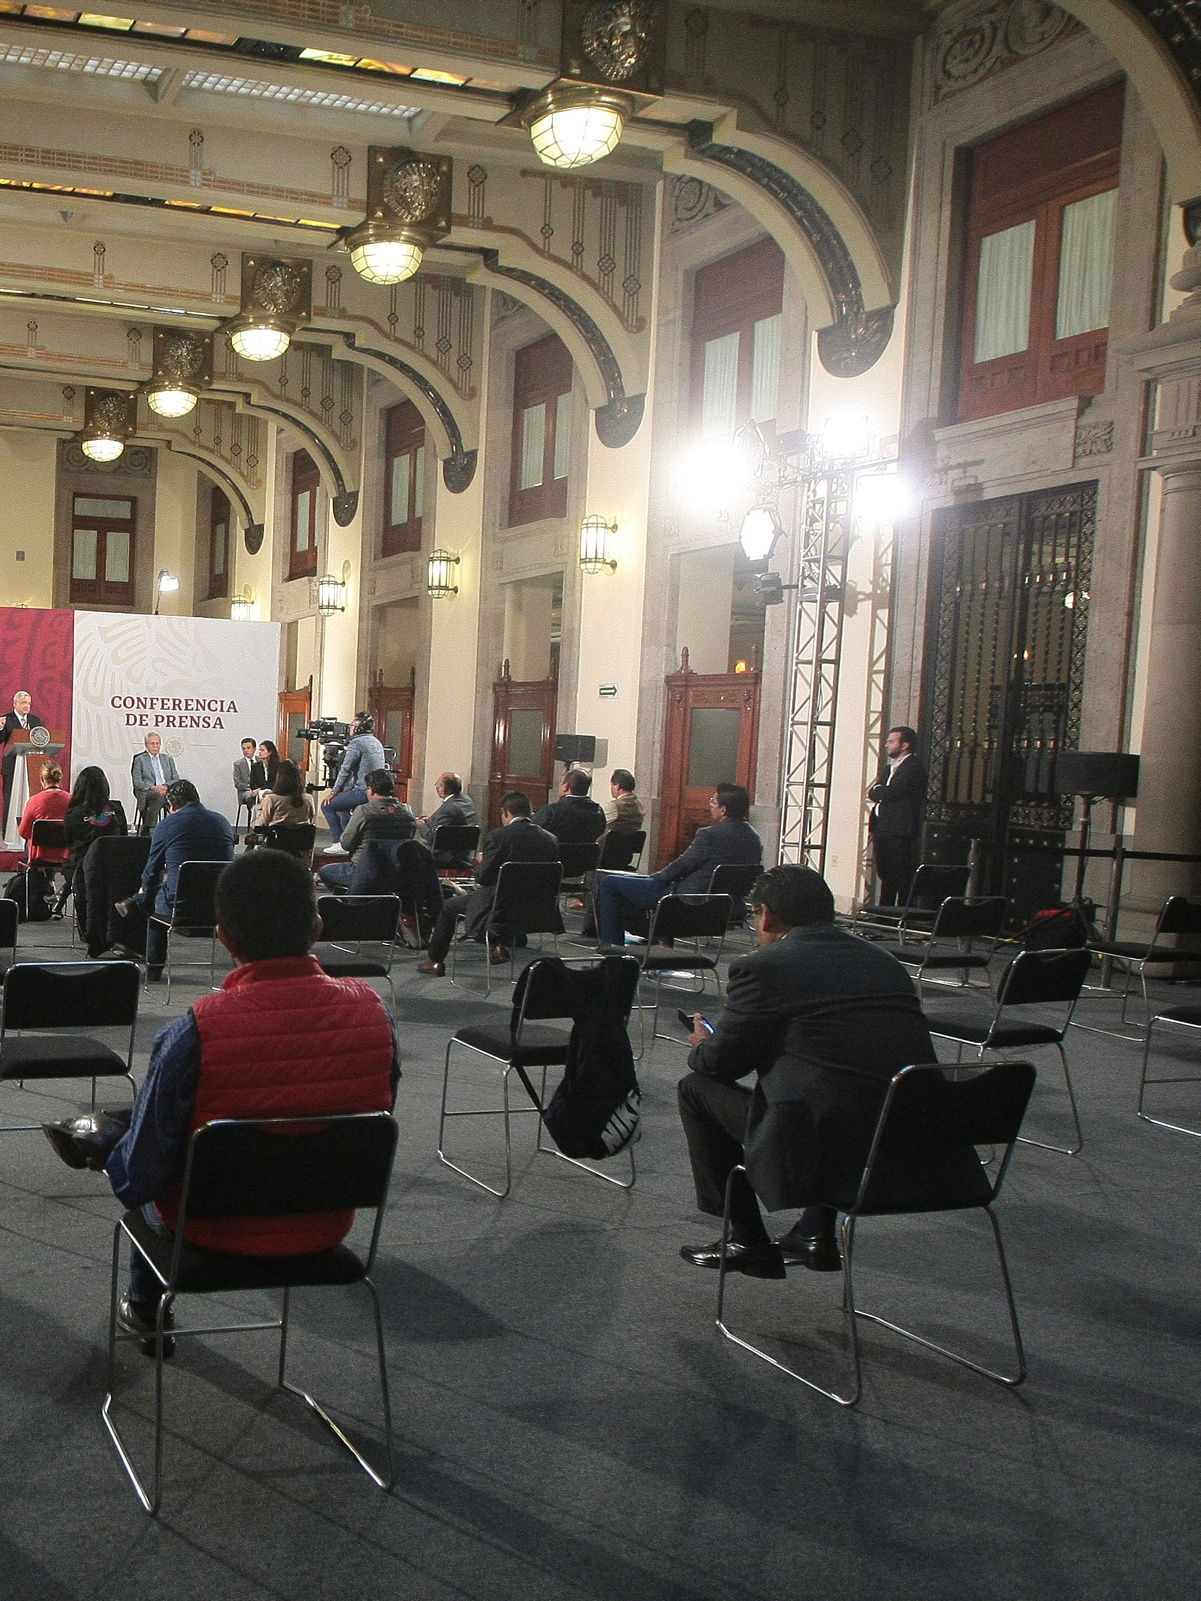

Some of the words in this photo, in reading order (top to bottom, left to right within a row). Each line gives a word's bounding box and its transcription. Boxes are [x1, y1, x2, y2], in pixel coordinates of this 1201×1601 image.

[110, 695, 239, 713] CONFERENCIA
[125, 713, 149, 726] DE
[154, 714, 225, 729] PRENSA
